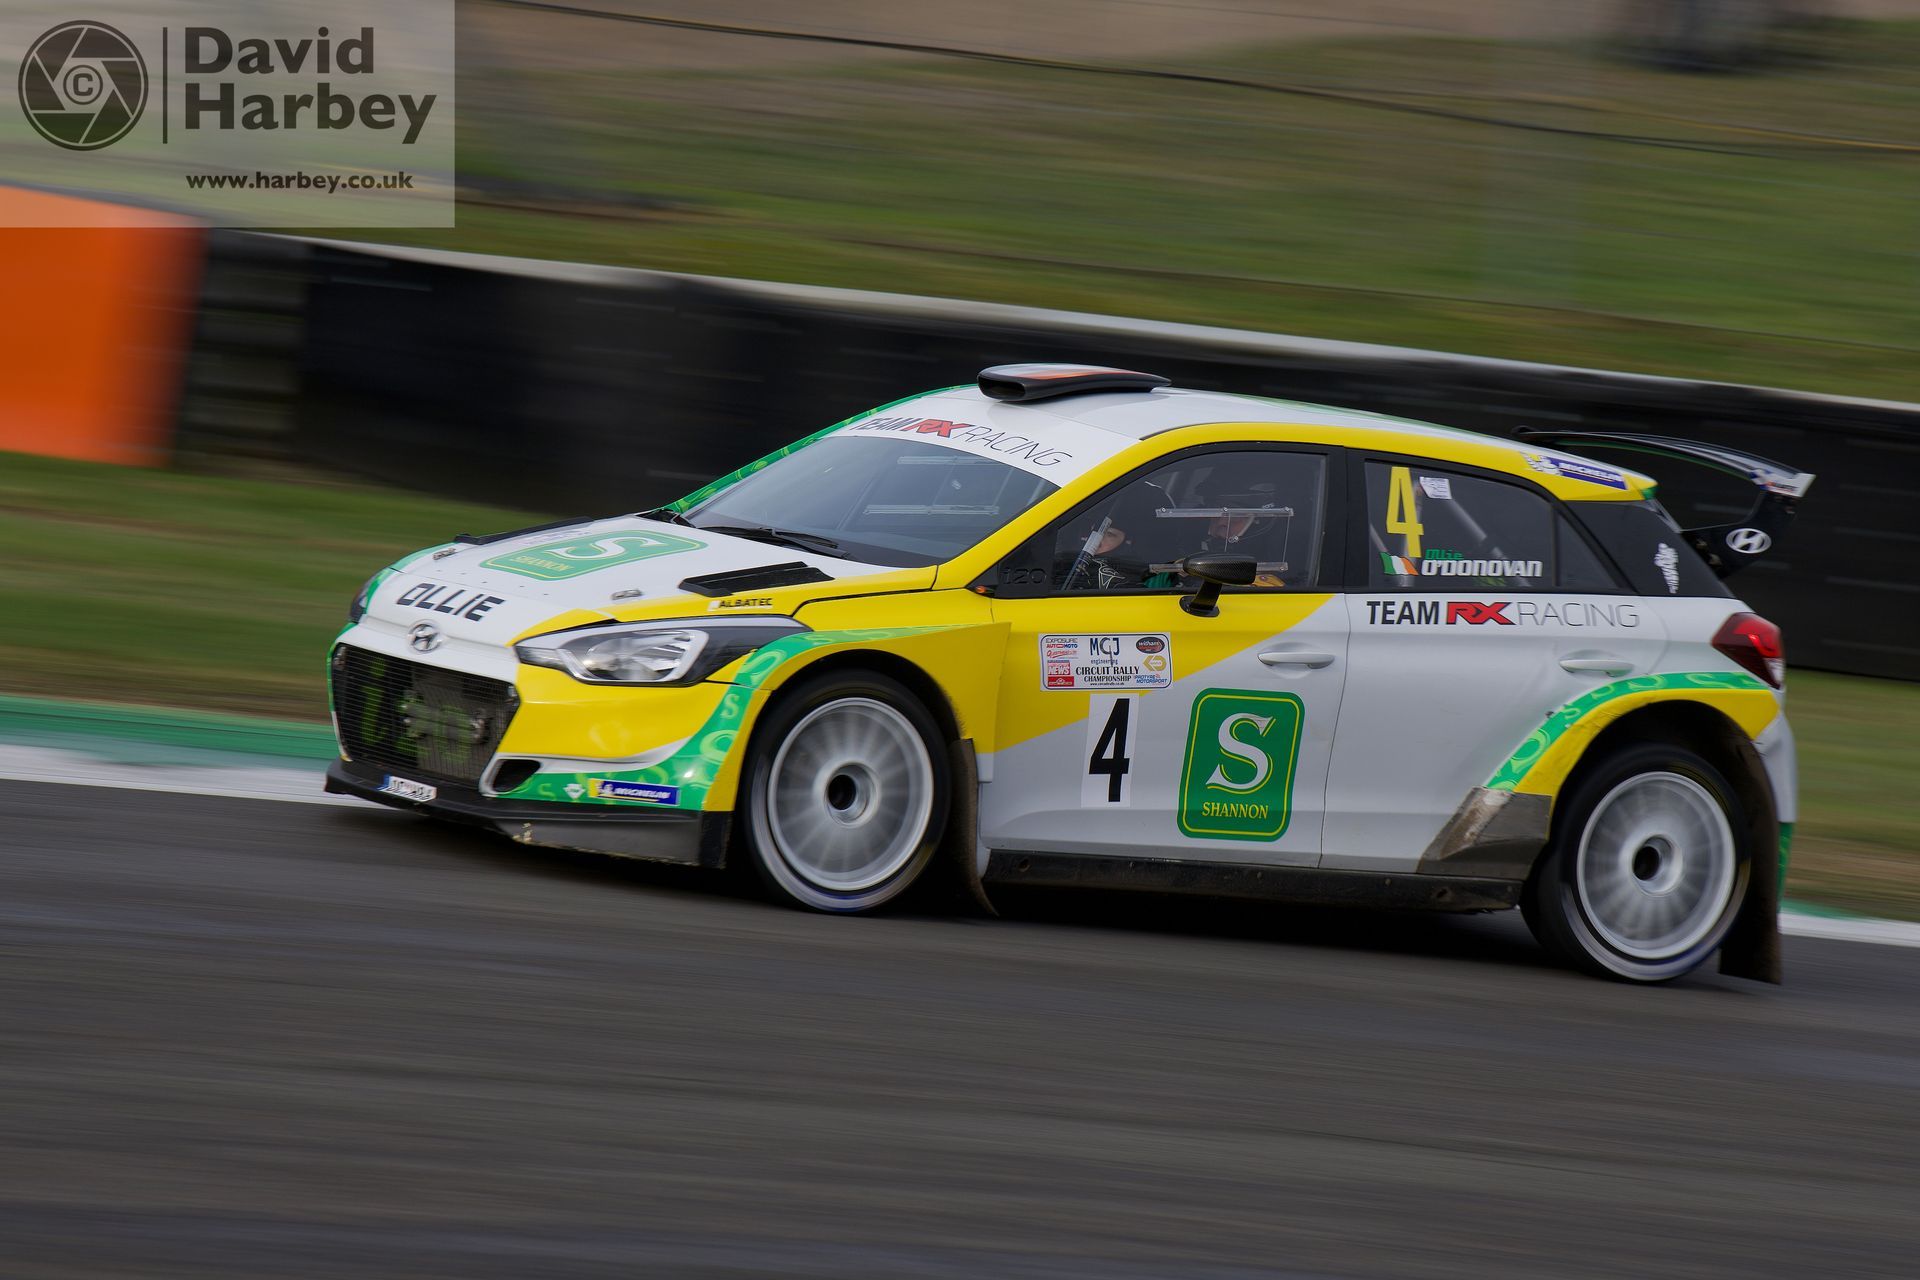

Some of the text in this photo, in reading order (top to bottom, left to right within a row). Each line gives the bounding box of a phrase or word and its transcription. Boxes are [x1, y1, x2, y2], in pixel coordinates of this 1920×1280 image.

[953, 426, 1073, 467] RACING
[1386, 466, 1424, 558] 4
[396, 582, 505, 622] OLLIE
[1366, 601, 1640, 627] TEAM RX RACING
[1048, 665, 1070, 675] NEWS
[1075, 666, 1140, 676] CIRCUIT RALLY
[1083, 675, 1132, 683] CHAMPIONSHIP
[1088, 698, 1131, 802] 4
[1205, 712, 1276, 794] S
[1202, 801, 1269, 819] SHANNON
